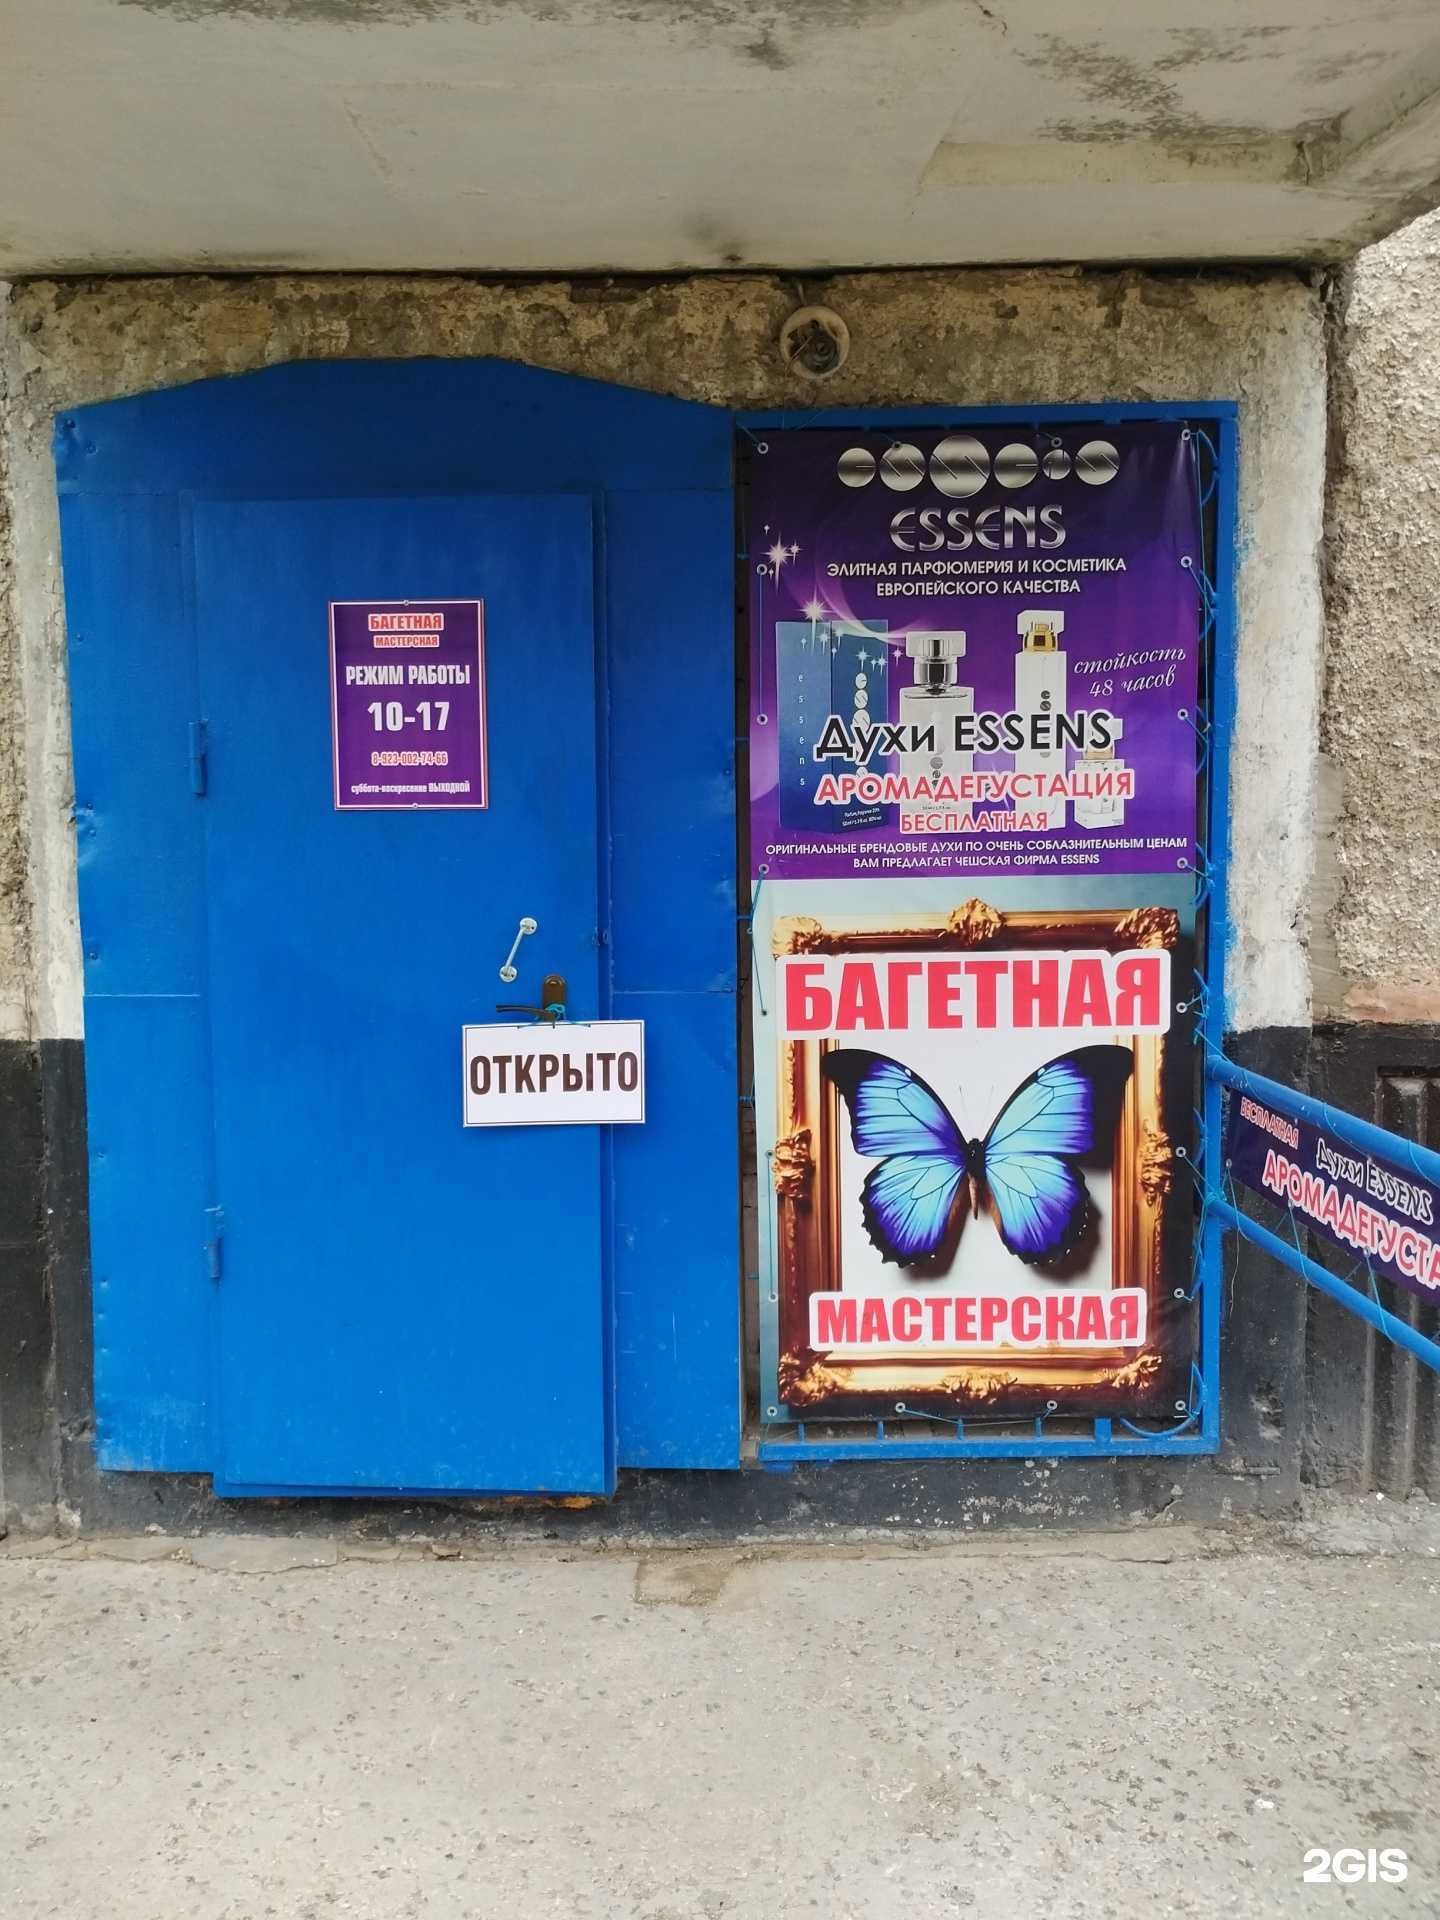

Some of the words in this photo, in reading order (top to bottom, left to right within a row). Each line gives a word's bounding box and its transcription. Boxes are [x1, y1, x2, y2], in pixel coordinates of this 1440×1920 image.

[890, 504, 1067, 552] ESSENS
[827, 563, 897, 577] ЭЛИТНАЯ
[901, 560, 1013, 576] ПАРФЮМЕРИЯ
[1018, 560, 1029, 573] И
[1032, 558, 1127, 573] КОСМЕТИКА
[876, 579, 999, 597] ЕВРОПЕЙСКОГО
[1003, 579, 1081, 594] КАЧЕСТВА
[370, 614, 443, 630] БАГЕТНАЯ
[375, 636, 439, 647] МАСТЕРСКАЯ
[346, 666, 404, 685] РЕЖИМ
[408, 665, 471, 685] РАБОТЫ
[1073, 648, 1186, 675] стойкость
[1090, 679, 1113, 697] 48
[1121, 664, 1177, 693] часов
[368, 701, 450, 731] 10-17
[815, 717, 936, 763] Духи
[954, 712, 1113, 752] ESSENS
[817, 771, 1132, 802] АРОМАДЕГУСТАЦИЯ
[900, 811, 1050, 833] БЕСПЛАТНАЯ
[765, 843, 857, 855] ОРИГИНАЛЬНЫЕ
[860, 842, 928, 854] БРЕНДОВЫЕ
[931, 842, 963, 853] ДУХИ
[966, 840, 983, 851] ПО
[986, 841, 1024, 851] ОЧЕНЬ
[1027, 838, 1144, 850] СОБЛАЗНИТЕЛЬНЫМ
[1147, 837, 1188, 849] ЦЕНАМ
[853, 857, 879, 868] ВАМ
[882, 856, 952, 868] ПРЕДЛАГАЕТ
[955, 854, 1011, 867] ЧЕШСКАЯ
[1013, 855, 1058, 866] ФИРМА
[1061, 854, 1100, 865] ESSENS
[785, 957, 1161, 1031] БАГЕТНАЯ
[470, 1051, 639, 1096] ОТКРЫТО
[1316, 1137, 1364, 1188] Духи
[1366, 1157, 1434, 1225] ESSENS
[817, 1295, 1139, 1344] МАСТЕРСКАЯ
